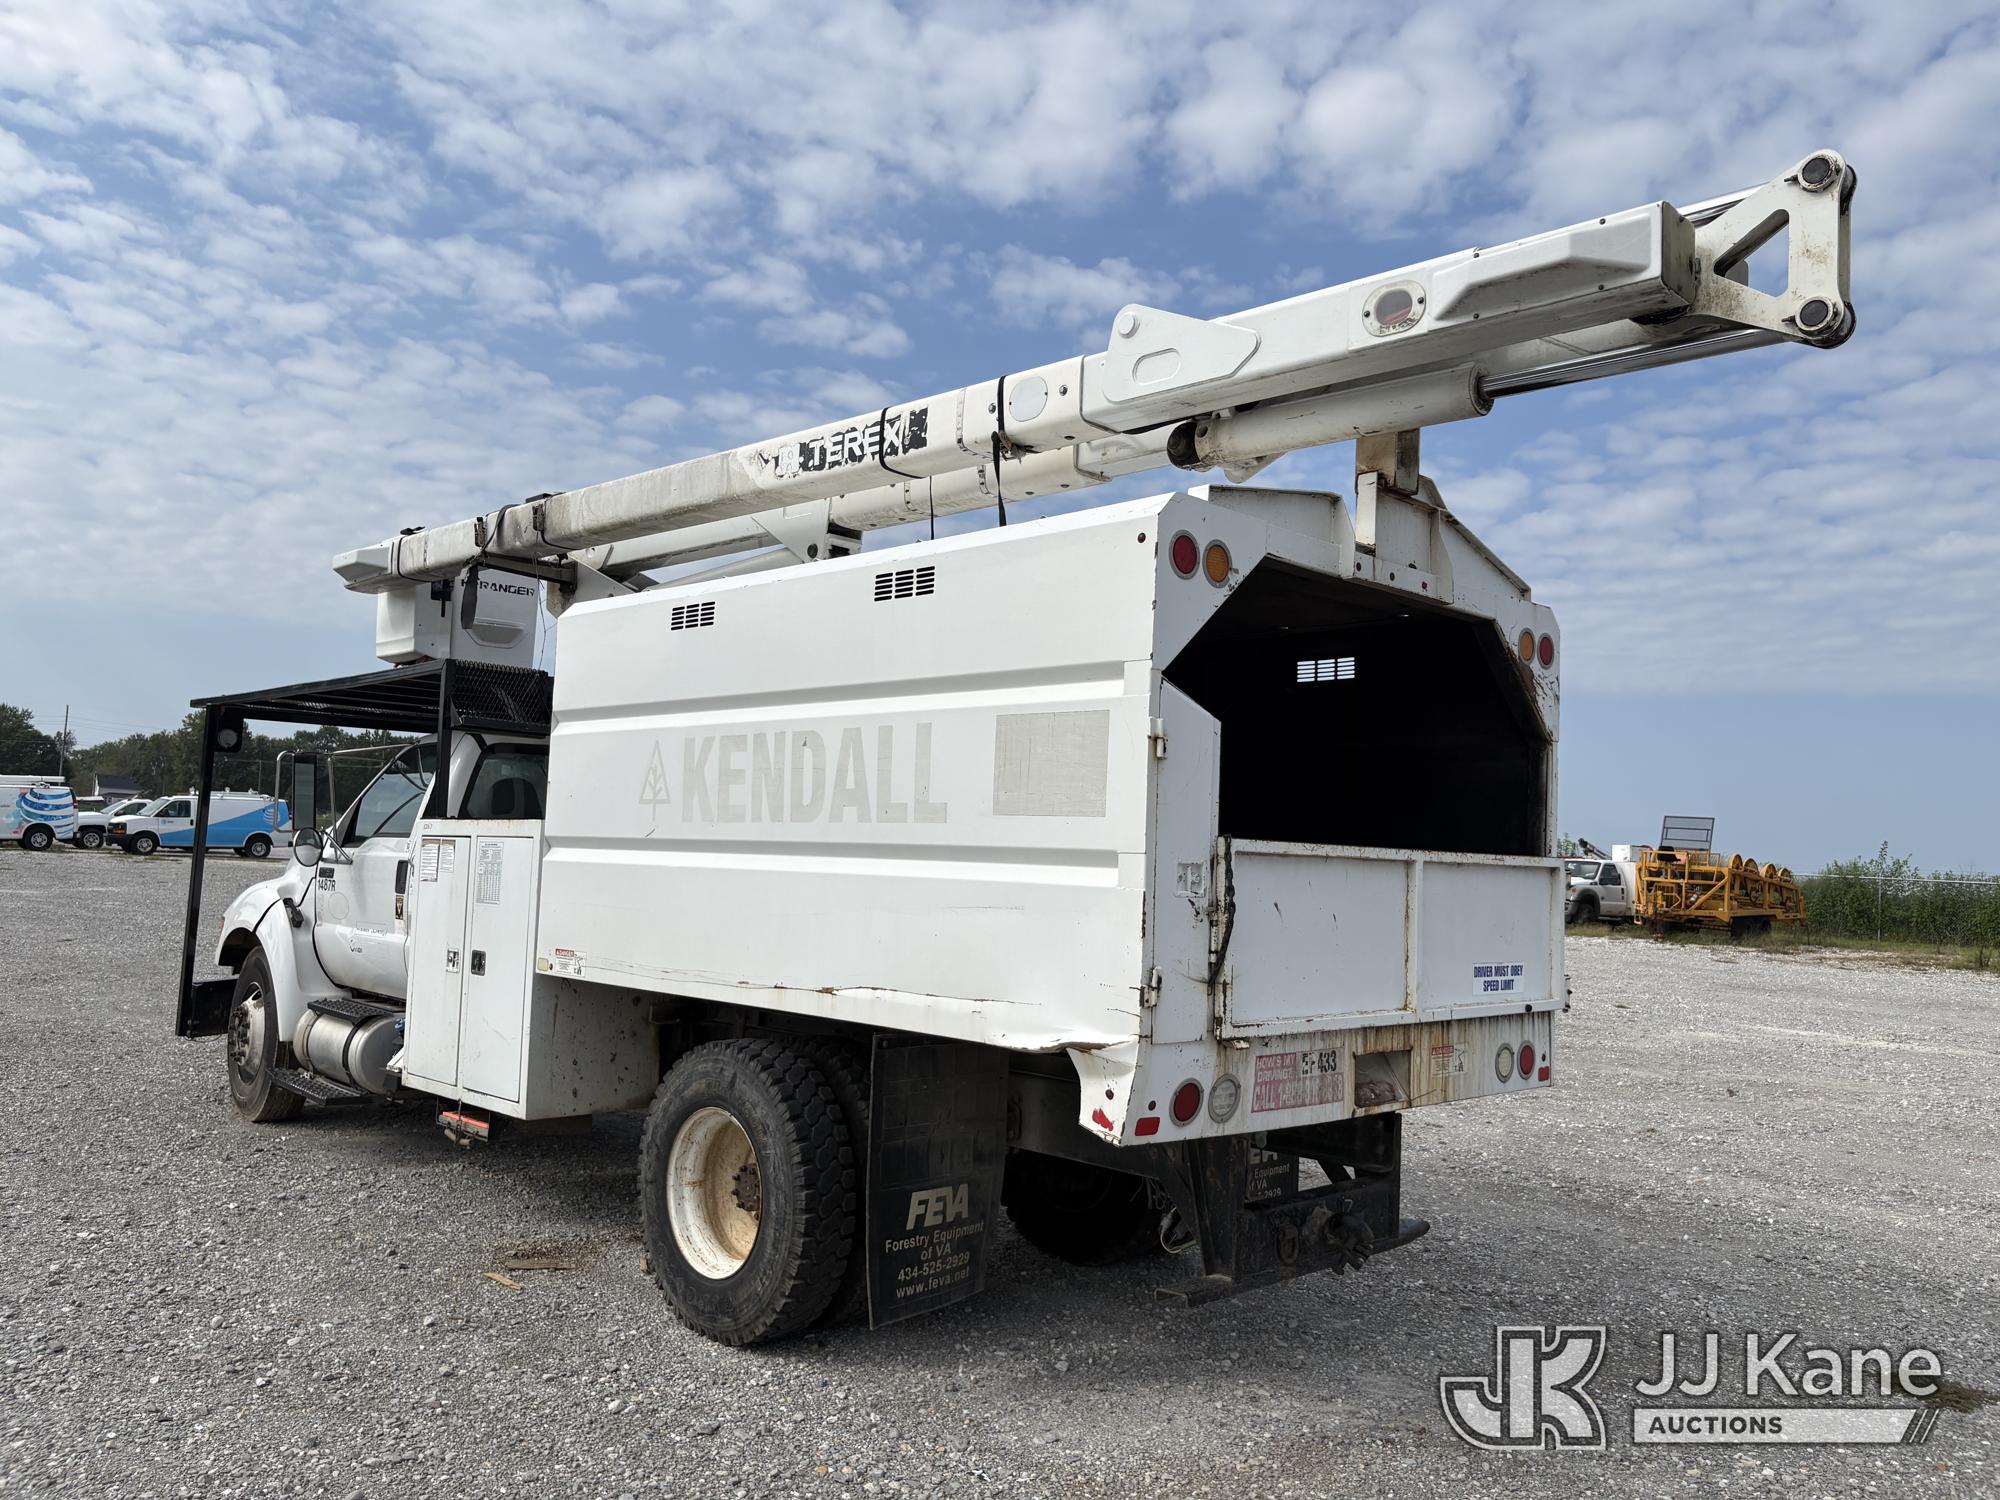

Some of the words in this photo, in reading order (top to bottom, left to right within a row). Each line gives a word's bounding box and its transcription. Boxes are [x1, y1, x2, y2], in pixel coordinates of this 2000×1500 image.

[809, 418, 902, 467] TEREX
[681, 721, 948, 824] KENDALL
[318, 878, 336, 892] 1487R
[1473, 966, 1493, 978] DRIVER
[1494, 965, 1509, 977] MUST
[1510, 964, 1524, 976] OBEY
[1483, 979, 1500, 992] SPEED
[1500, 979, 1514, 991] LIMIT
[1283, 1054, 1295, 1066] MY
[1253, 1083, 1276, 1111] CALL
[1254, 1163, 1290, 1178] Equipment
[1256, 1179, 1268, 1190] VA
[905, 1183, 969, 1230] FEVA
[885, 1234, 930, 1254] Forestry
[933, 1219, 984, 1245] Equipment
[920, 1246, 932, 1261] of
[935, 1242, 952, 1257] VA
[897, 1251, 970, 1282] 434-525-2929
[896, 1266, 970, 1299] www.feva.net
